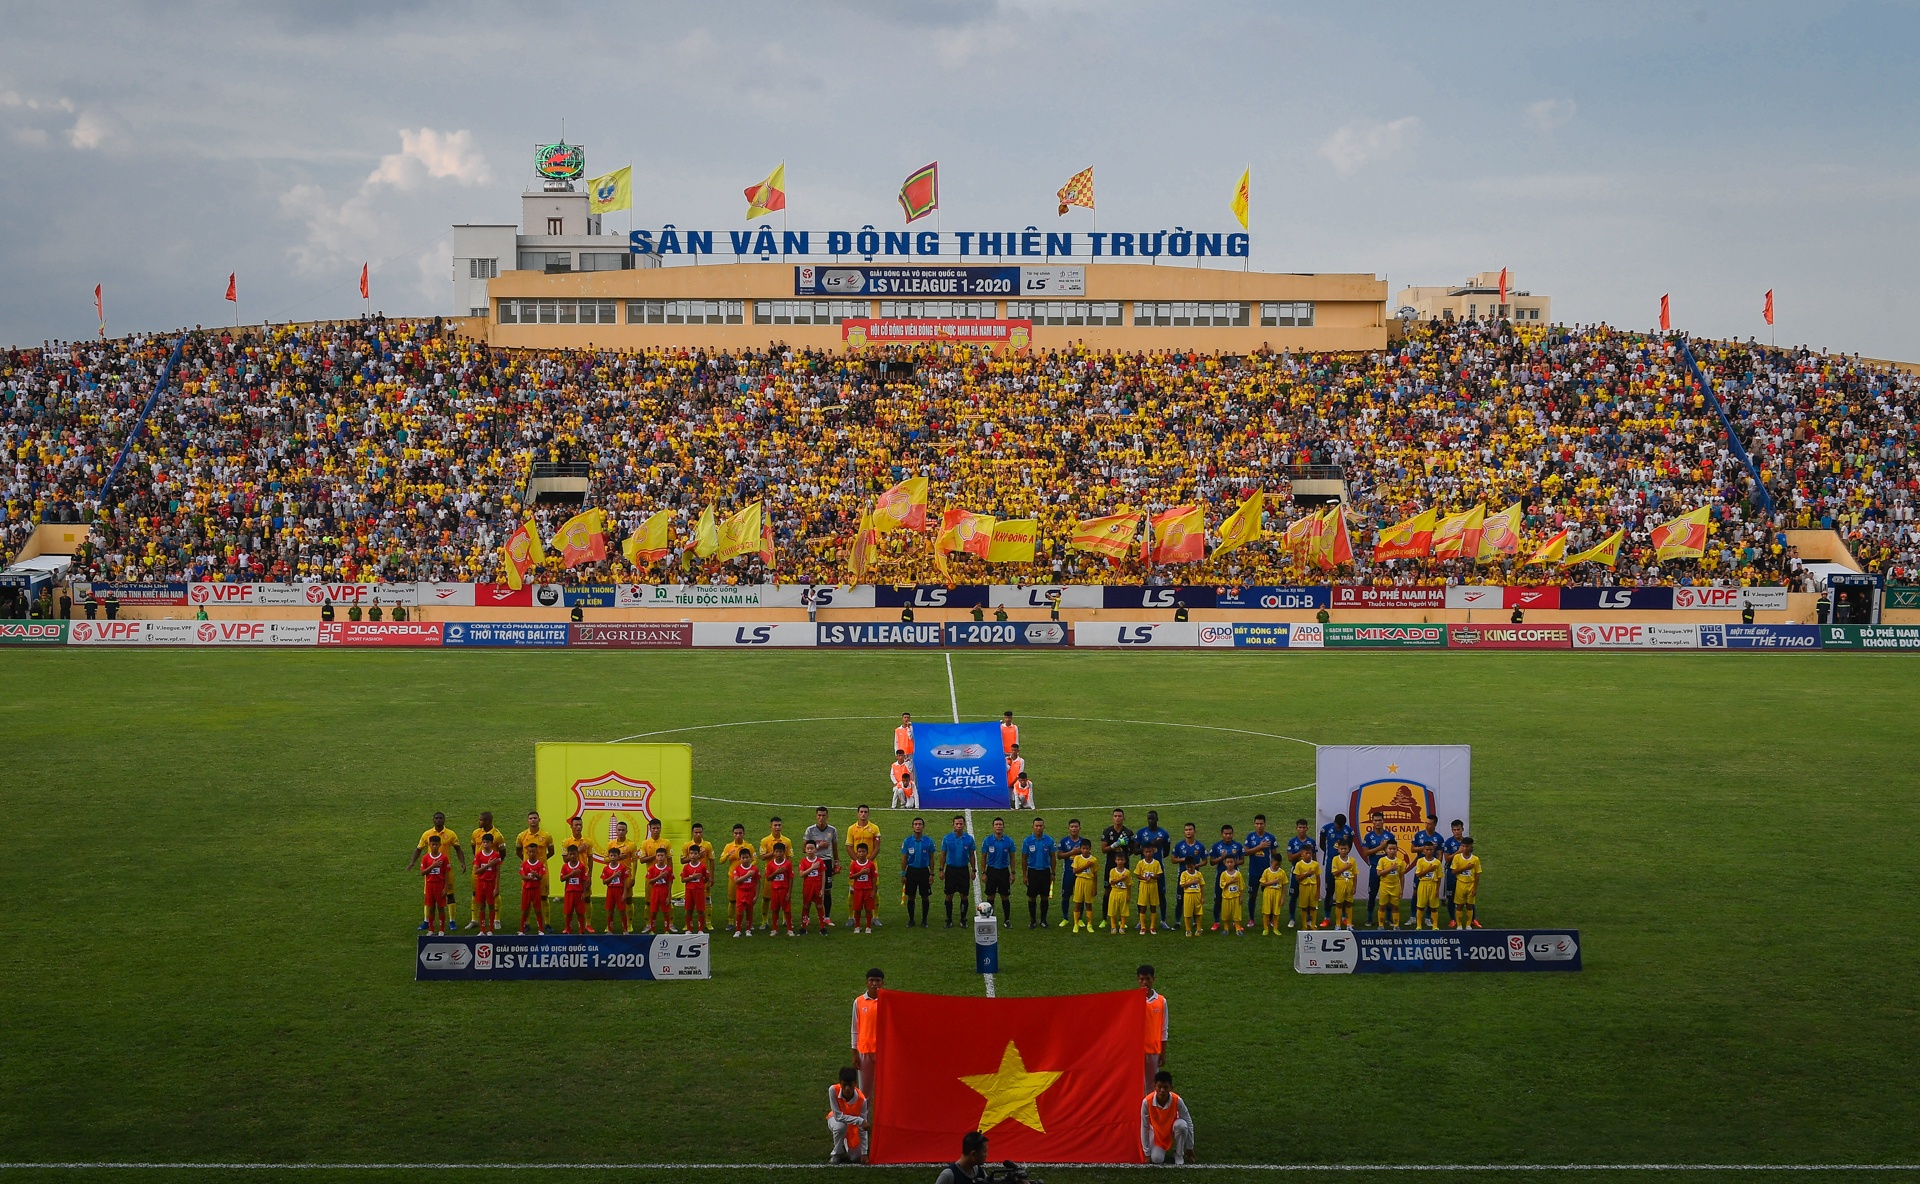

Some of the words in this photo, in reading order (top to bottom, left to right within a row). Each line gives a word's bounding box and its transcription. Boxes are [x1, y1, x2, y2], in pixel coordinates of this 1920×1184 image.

[629, 224, 713, 255] SÂN
[729, 224, 809, 261] VẬN
[827, 224, 940, 262] ĐỘNG
[954, 226, 1072, 256] THIÊN
[1087, 226, 1250, 257] TRƯỜNG
[869, 269, 882, 277] GIẢI
[883, 269, 901, 277] BÓNG
[901, 269, 911, 277] ĐÁ
[921, 270, 937, 278] ĐỊCH
[938, 269, 956, 278] QUỐC
[869, 278, 888, 293] LS
[890, 278, 958, 293] V.LEAGUE
[961, 278, 1012, 293] 1-2020
[1026, 279, 1046, 290] LS
[957, 325, 970, 336] NAM
[971, 323, 979, 336] HÀ
[979, 325, 992, 336] NAM
[992, 325, 1006, 338] ĐỊNH
[128, 590, 142, 598] TINH
[143, 588, 159, 599] KHIẾT
[160, 588, 170, 599] HẢI
[170, 590, 184, 599] NAM
[211, 585, 253, 600] VPF
[327, 585, 368, 600] VPF
[719, 586, 738, 594] uống
[1380, 587, 1399, 600] PHẾ
[1402, 590, 1427, 600] NAM
[1428, 588, 1445, 600] HÀ
[586, 598, 602, 606] KIỆN
[696, 593, 719, 606] ĐỘC
[721, 595, 743, 604] NAM
[745, 593, 759, 604] HÀ
[800, 588, 833, 606] LS
[914, 588, 948, 607] LS
[1028, 589, 1063, 606] LS
[1142, 589, 1176, 608] LS
[1598, 590, 1632, 609] LS
[1697, 589, 1738, 605] VPF
[96, 622, 140, 639] VPF
[220, 623, 265, 640] VPF
[320, 623, 342, 633] JG
[347, 625, 439, 635] JOGARBOLA
[470, 628, 492, 640] THỜI
[493, 630, 525, 640] TRANG
[525, 630, 565, 640] BALITEX
[820, 625, 846, 643] LS
[848, 625, 940, 643] V.LEAGUE
[948, 625, 1016, 643] 1-2020
[1029, 630, 1043, 638] LS
[1209, 627, 1233, 636] ADO
[1234, 626, 1248, 634] BẤT
[1250, 627, 1272, 635] ĐỘNG
[1299, 626, 1321, 634] ADO
[1355, 627, 1439, 640] MIKADO
[1598, 625, 1643, 642] VPF
[1729, 627, 1744, 636] MỘT
[1744, 627, 1755, 635] THẾ
[1755, 627, 1770, 635] GIỚI
[1876, 626, 1895, 637] PHẾ
[1896, 628, 1919, 637] NAM
[319, 633, 341, 643] BL
[596, 630, 682, 641] AGRIBANK
[735, 626, 771, 644] LS
[1117, 626, 1153, 644] LS
[1484, 629, 1517, 641] KING
[1518, 629, 1568, 641] COFFEE
[1706, 634, 1719, 647] 3
[1751, 632, 1777, 647] THỂ
[1778, 636, 1815, 647] THAO
[1245, 637, 1262, 645] HÒA
[1263, 637, 1277, 646] LẠC
[1862, 636, 1898, 647] KHÔNG
[942, 766, 980, 776] SHINE
[932, 774, 996, 786] TOGETHER
[585, 789, 641, 798] NAMDINH
[1399, 825, 1420, 833] NAM
[1321, 939, 1346, 952] LS
[1361, 938, 1375, 946] GIẢI
[1393, 937, 1403, 945] ĐÁ
[1413, 938, 1430, 946] ĐỊCH
[1430, 936, 1448, 946] QUỐC
[496, 945, 510, 953] GIẢI
[510, 945, 529, 953] BÓNG
[529, 945, 539, 953] ĐÁ
[540, 945, 550, 953] VÔ
[550, 945, 567, 953] ĐỊCH
[568, 943, 587, 952] QUỐC
[675, 944, 702, 959] LS
[1361, 947, 1381, 961] LS
[1383, 946, 1452, 961] V.LEAGUE
[1454, 946, 1506, 960] 1-2020
[1533, 944, 1550, 953] LS
[426, 952, 443, 961] LS
[495, 954, 515, 969] LS
[517, 953, 589, 968] V.LEAGUE
[592, 953, 645, 968] 1-2020
